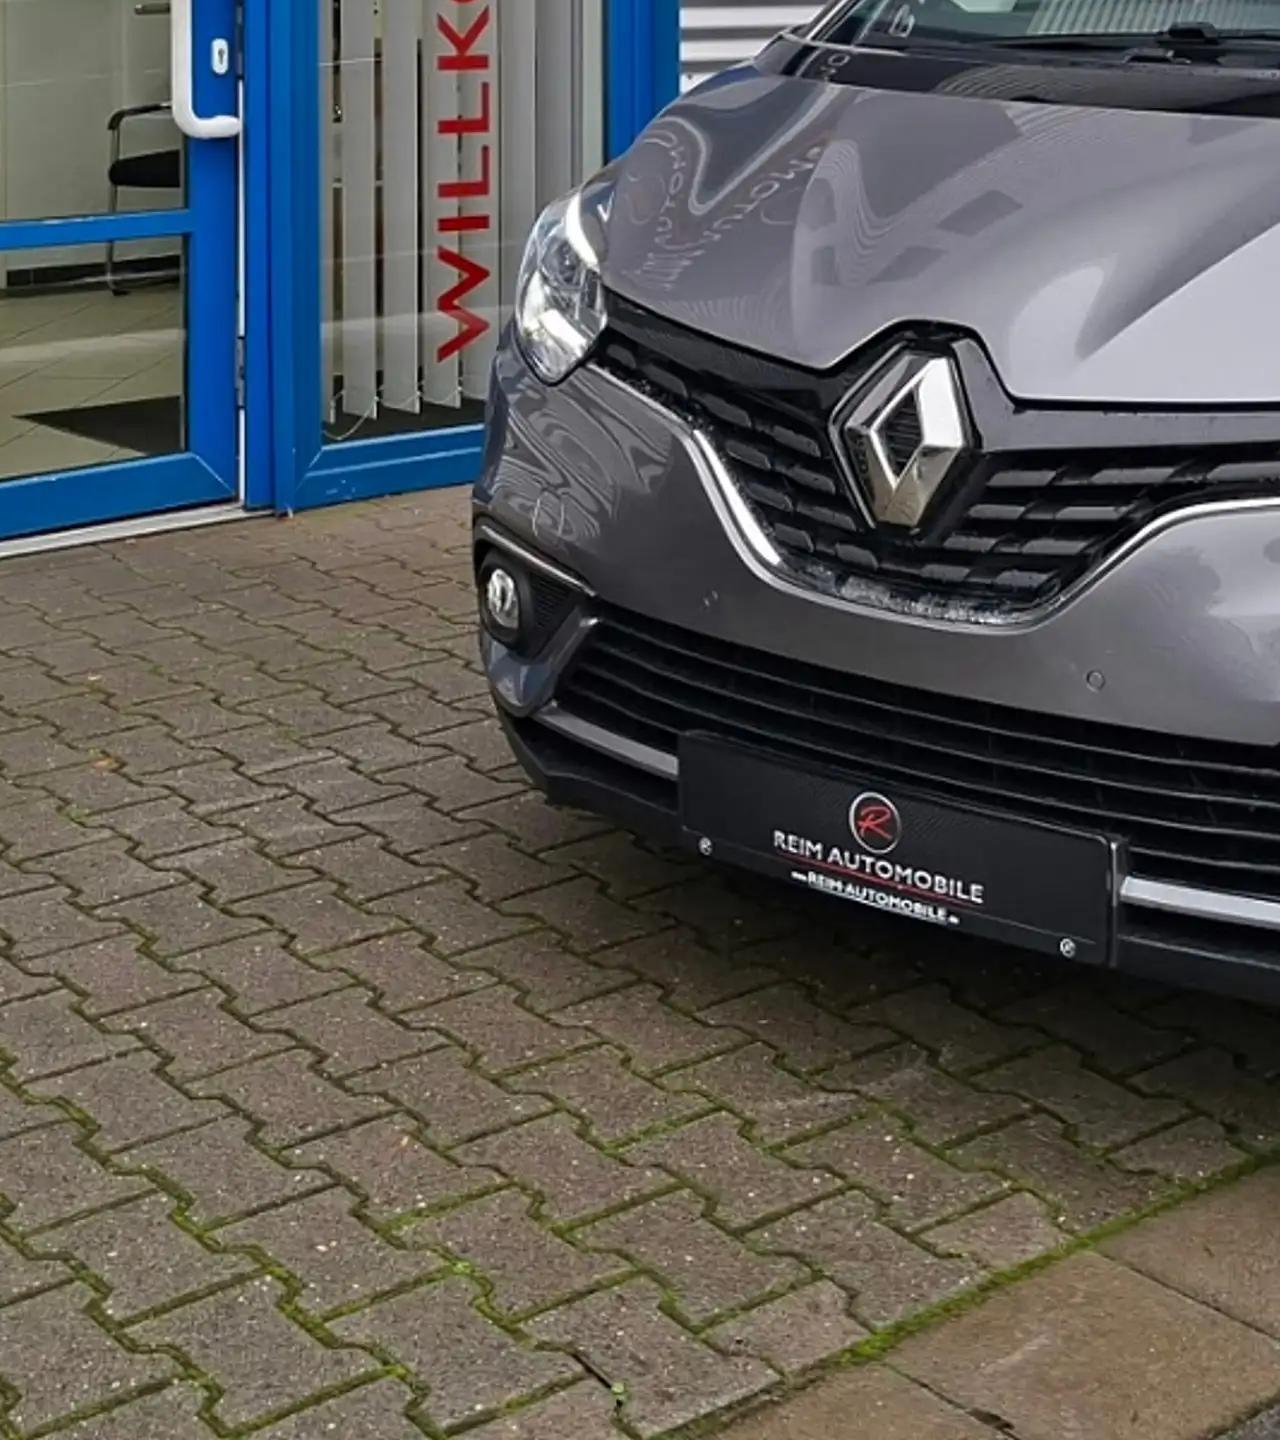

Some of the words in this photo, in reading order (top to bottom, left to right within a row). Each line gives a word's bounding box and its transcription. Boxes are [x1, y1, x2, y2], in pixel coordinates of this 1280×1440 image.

[773, 829, 824, 861] REIM
[826, 846, 985, 904] AUTOMOBILE
[807, 871, 844, 893] REIM
[844, 883, 948, 922] AUTOMOBILE
